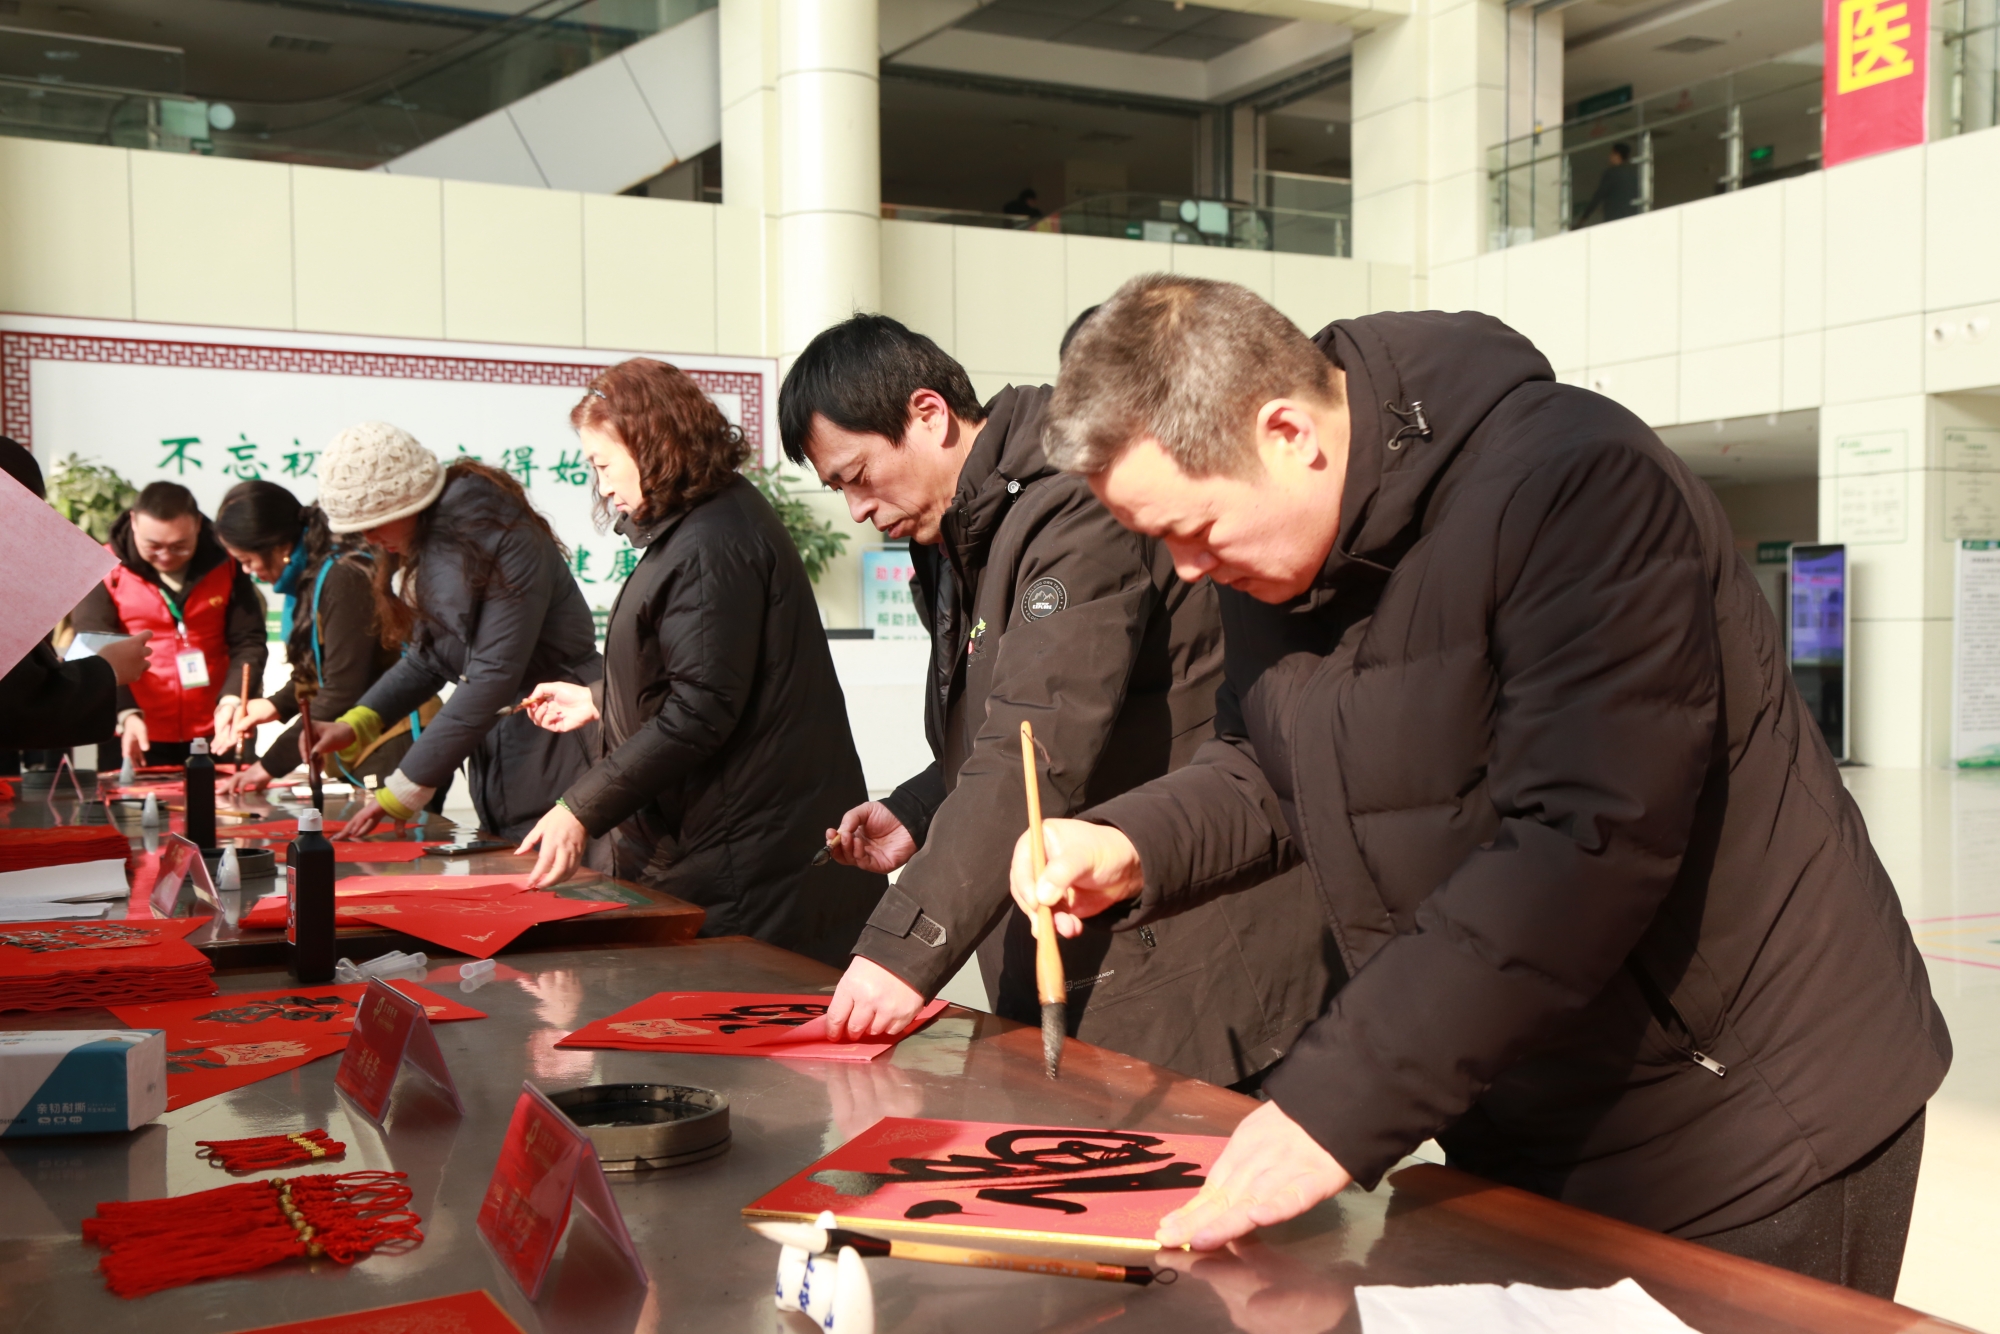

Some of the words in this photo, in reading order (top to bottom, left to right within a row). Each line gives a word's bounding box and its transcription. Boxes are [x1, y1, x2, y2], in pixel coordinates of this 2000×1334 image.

[1837, 0, 1914, 95] 医
[37, 1102, 86, 1115] 亲韧耐撕
